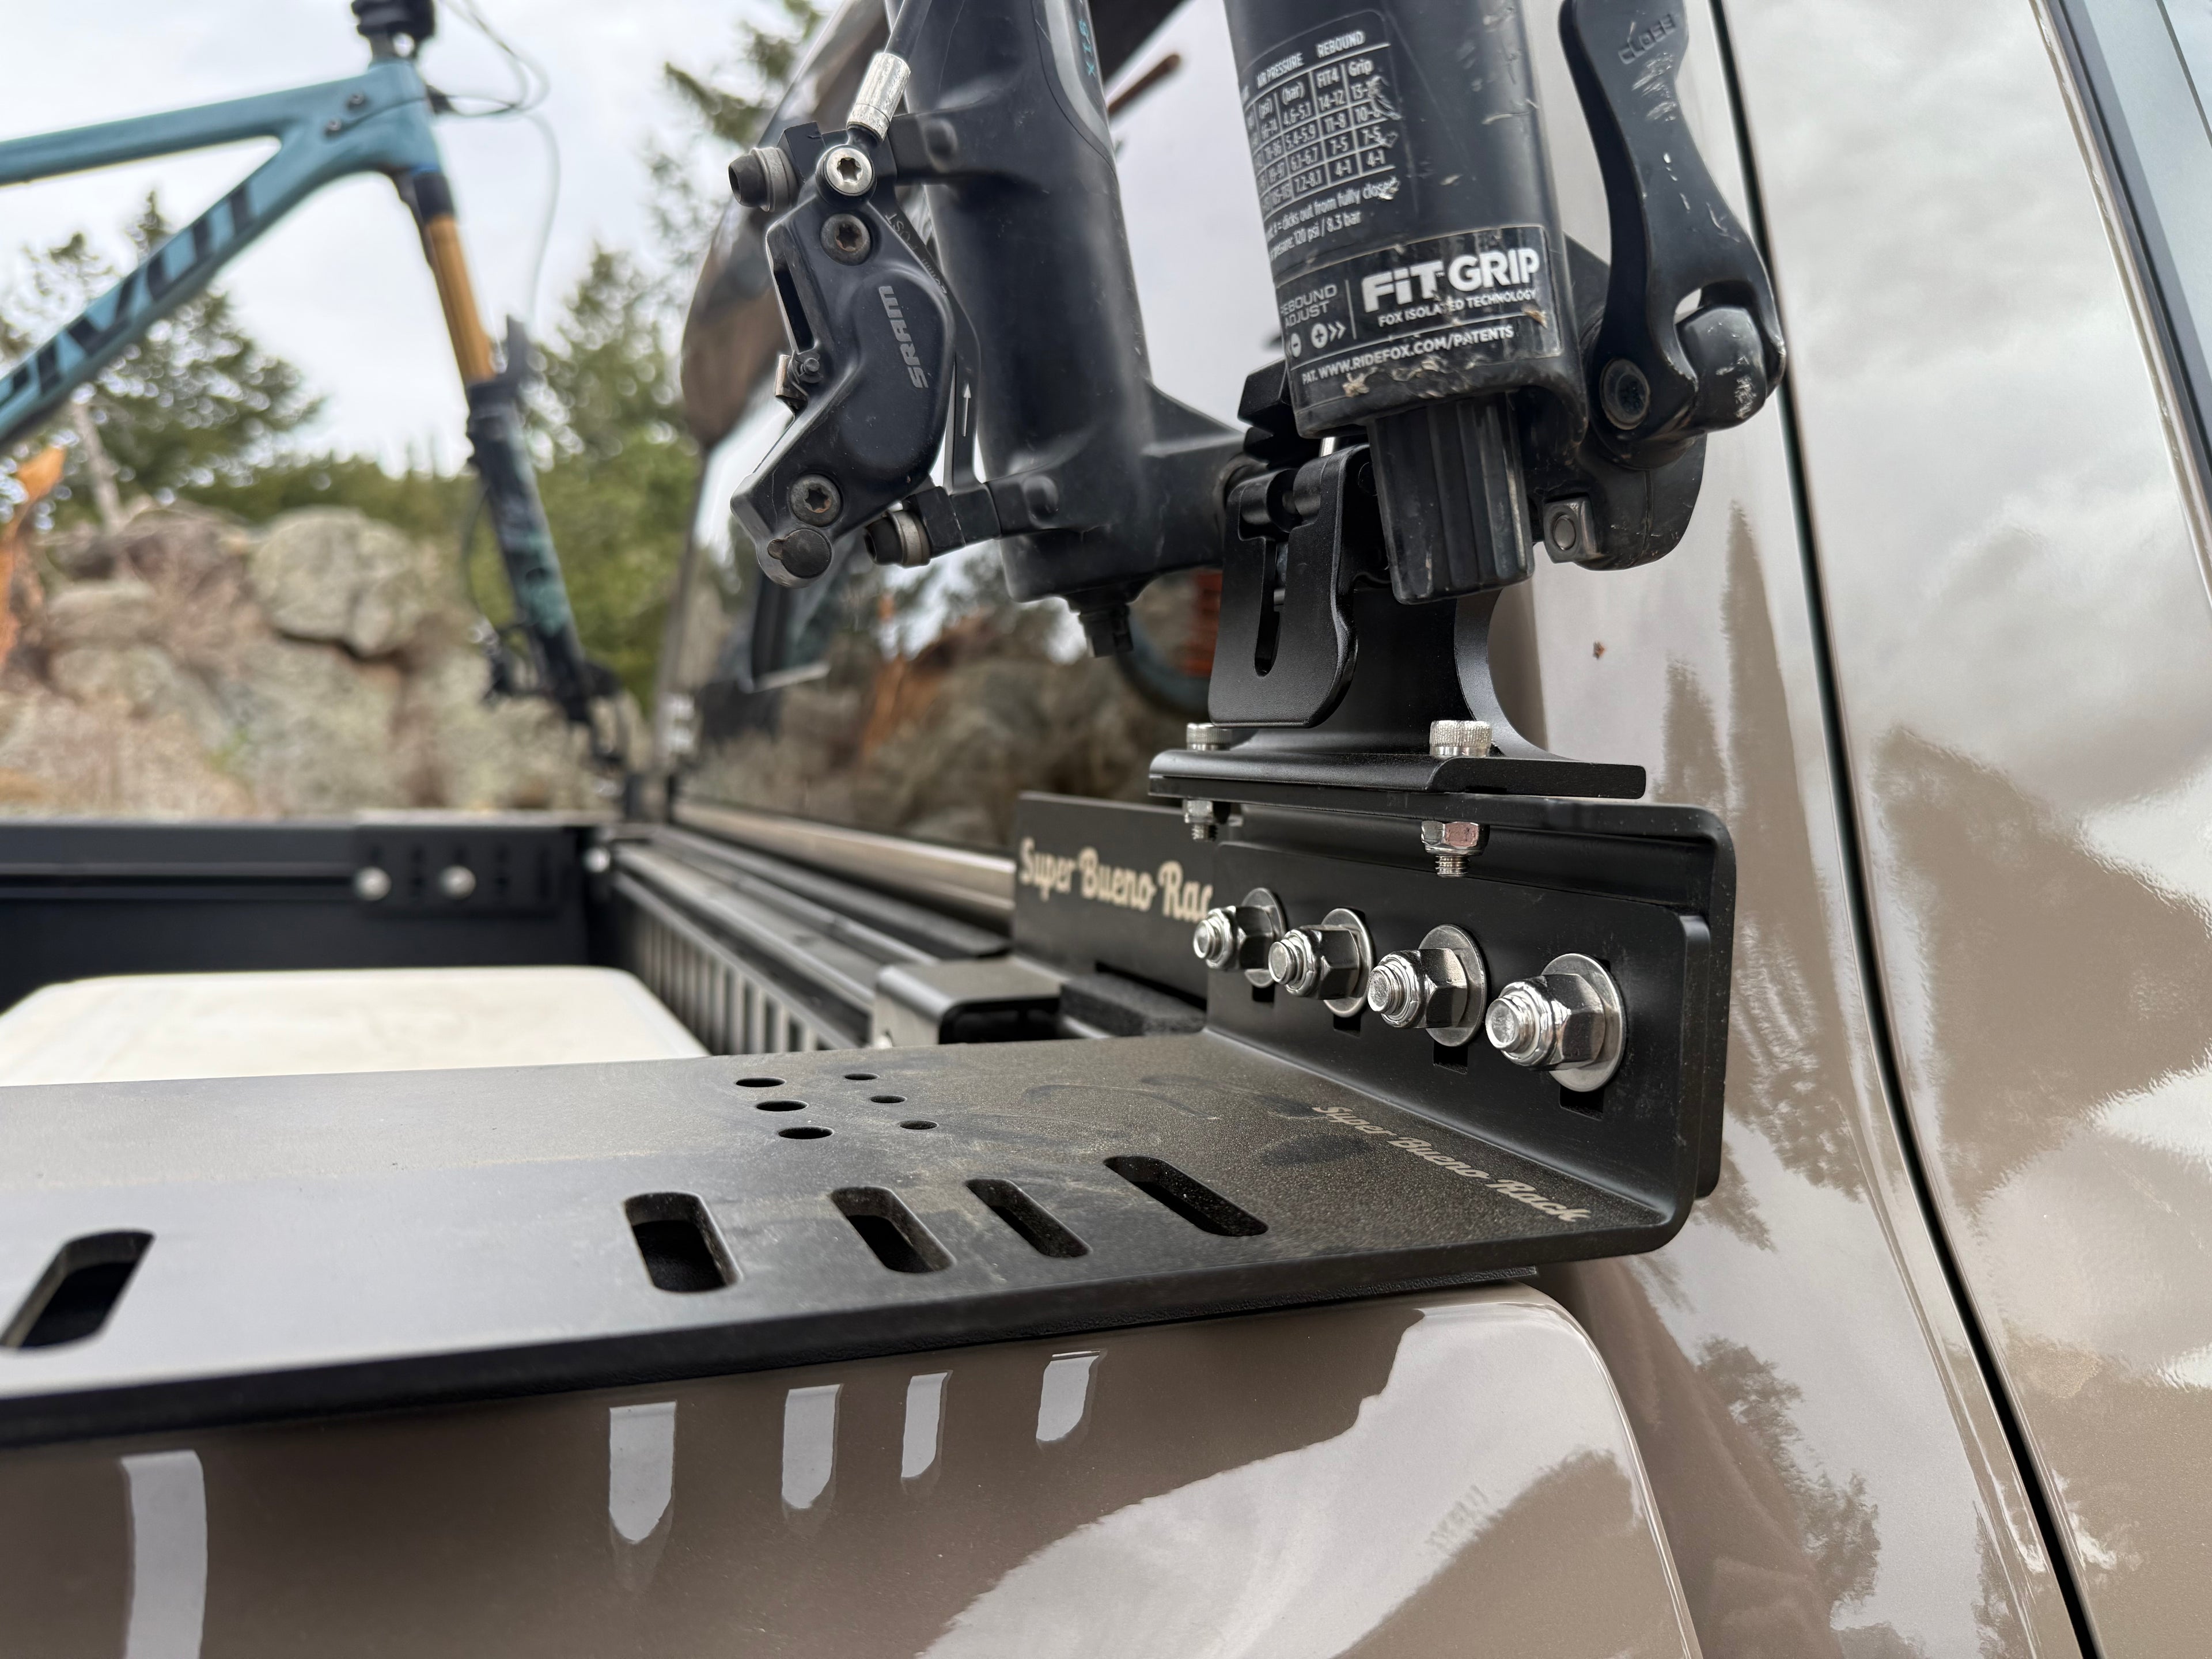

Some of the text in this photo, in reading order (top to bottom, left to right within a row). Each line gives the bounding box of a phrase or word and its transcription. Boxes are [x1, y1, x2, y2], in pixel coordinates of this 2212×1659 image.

[1315, 30, 1366, 58] REBOUND
[1316, 67, 1340, 88] FIT4
[1348, 59, 1374, 77] Grip
[1281, 81, 1305, 105] (bar)
[1318, 89, 1345, 111] 14-12
[1324, 113, 1347, 133] 11-8
[1361, 125, 1382, 145] 7-5
[1286, 123, 1316, 150] 5.4-5.9
[1330, 135, 1349, 156] 7-5
[1290, 146, 1319, 172] 6.1-6.7
[1334, 157, 1353, 177] 4-1
[1366, 149, 1386, 168] 4-1
[1313, 198, 1338, 217] from
[1336, 188, 1361, 207] fully
[1362, 176, 1401, 200] clos
[1326, 213, 1343, 233] 8.3
[1343, 210, 1362, 228] bar
[1448, 248, 1540, 292] GRIP
[1285, 300, 1330, 328] ADJUST
[1377, 288, 1537, 327] FOX ISOLAED TECHNOLOGY
[878, 286, 929, 388] SRAM
[1302, 324, 1515, 385] PAT. WWW.RIDEFOX.COM/PATENTS
[1018, 836, 1214, 923] Super Bueno Rac
[1312, 1105, 1593, 1223] Super Bueno Rack
